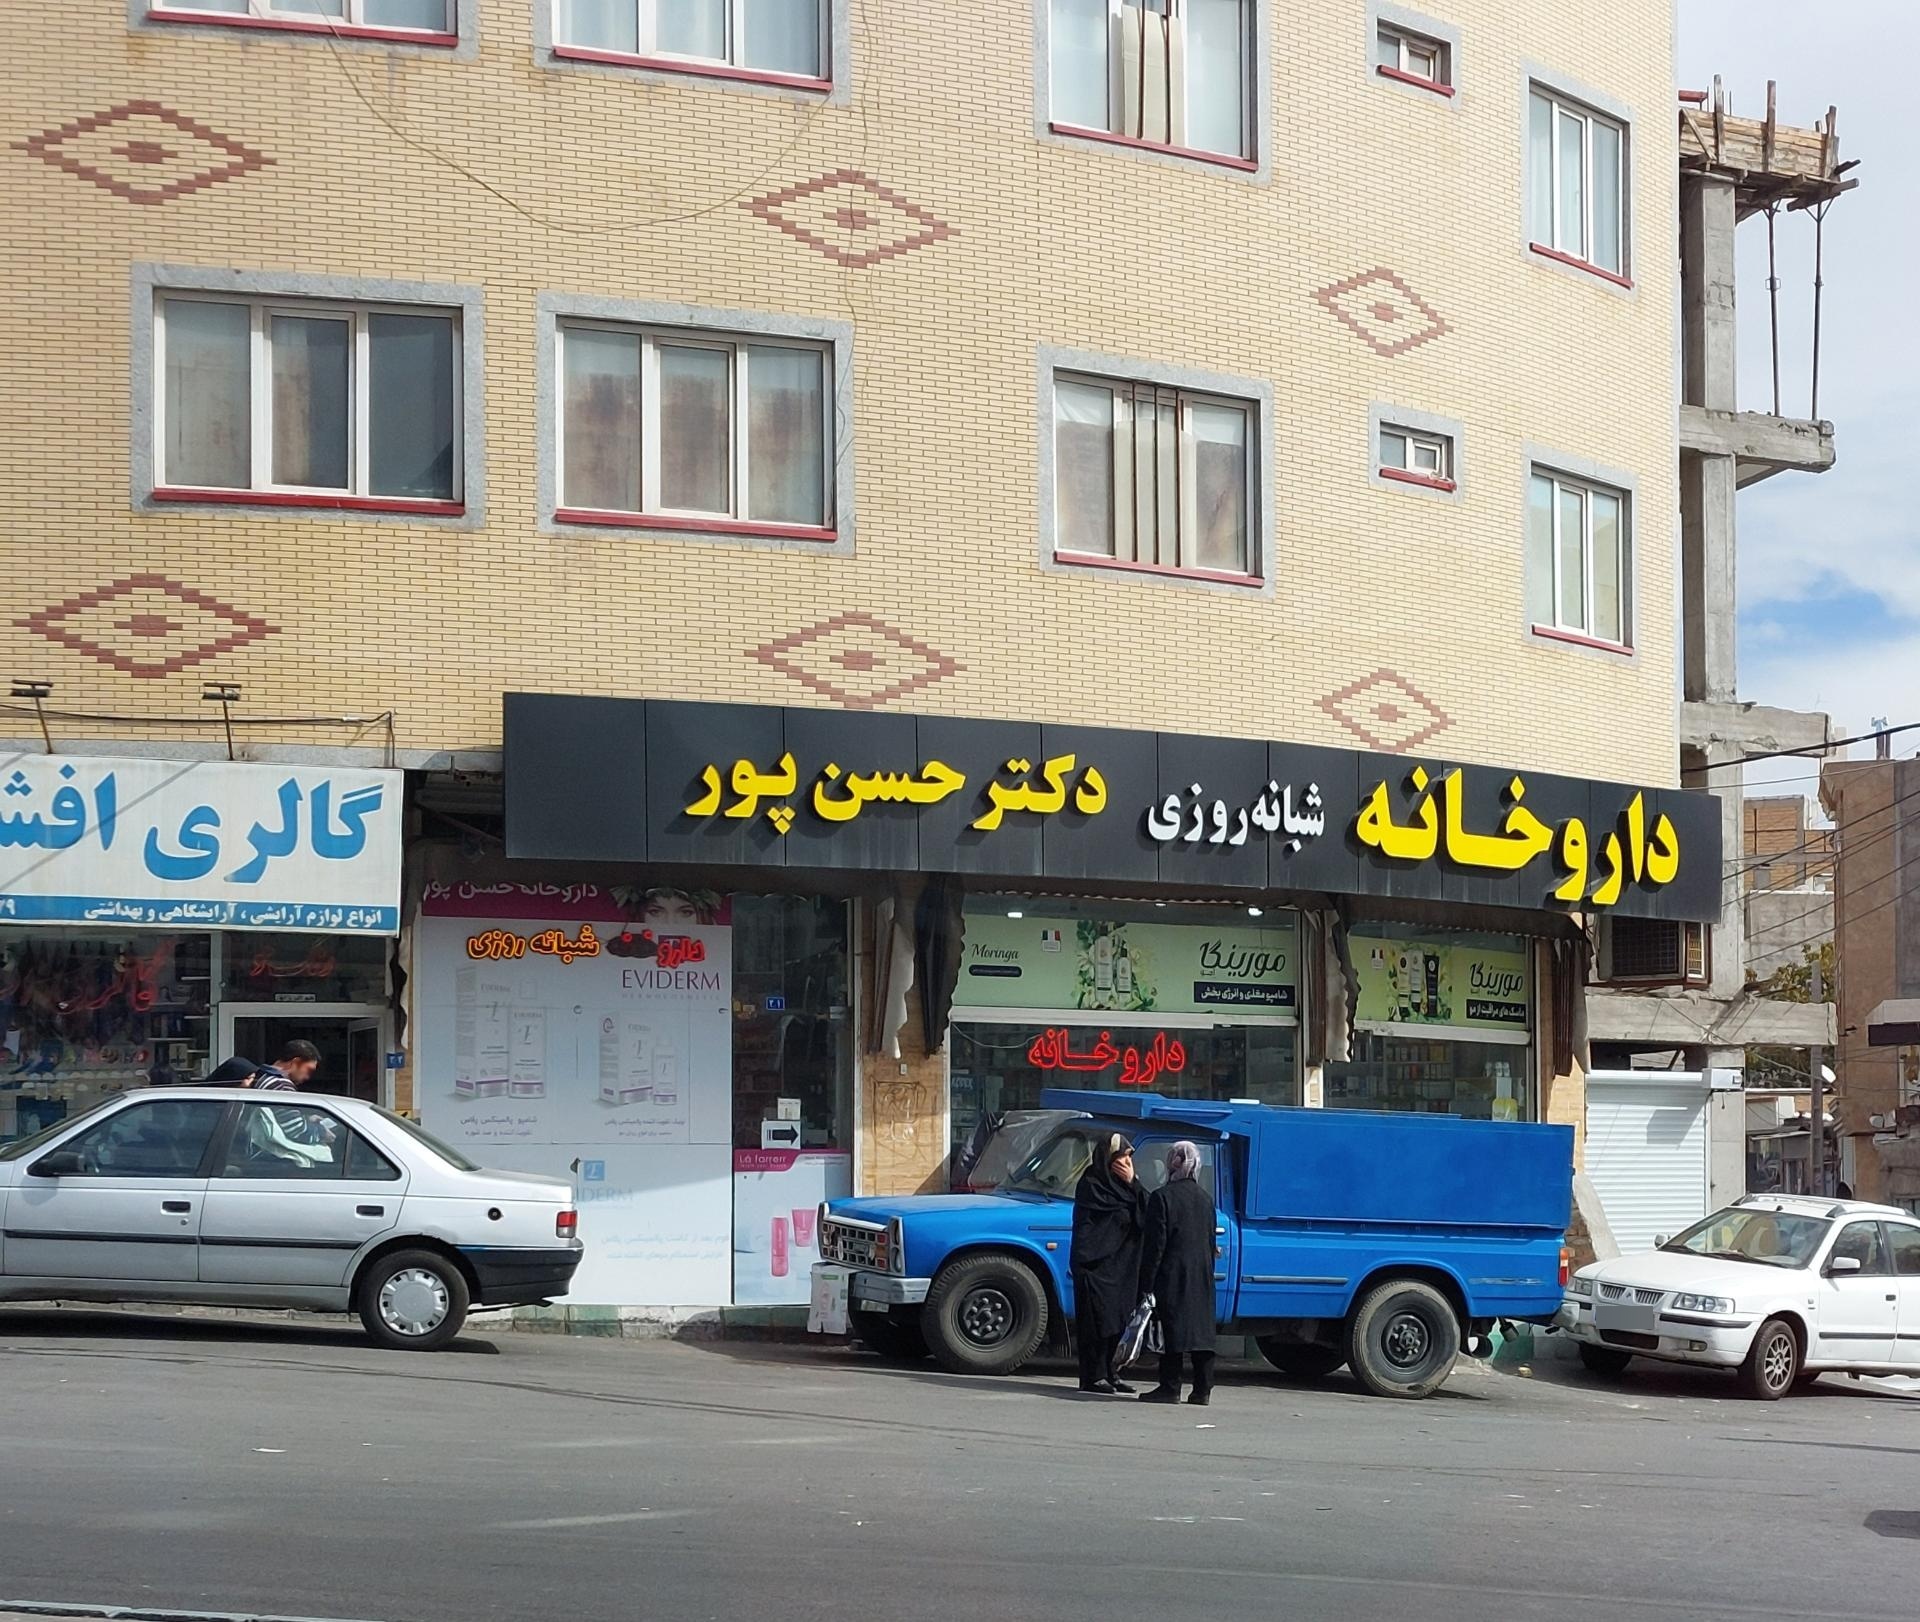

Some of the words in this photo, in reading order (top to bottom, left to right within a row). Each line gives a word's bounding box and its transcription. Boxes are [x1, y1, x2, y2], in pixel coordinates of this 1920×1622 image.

[685, 751, 799, 835] پور
[812, 760, 967, 822] حسن
[969, 753, 1108, 830] دکتر
[143, 776, 385, 884] گالری
[1147, 782, 1249, 846] روزی
[1250, 779, 1326, 853] شبانه
[1357, 765, 1679, 906] داروخانه
[84, 900, 144, 920] بهداشتی
[146, 906, 156, 922] و
[158, 902, 238, 924] آرایشگاهی
[306, 905, 344, 928] لوازم
[347, 907, 383, 929] انواع
[467, 929, 527, 961] روزی
[529, 924, 601, 964] شبانه
[971, 942, 1020, 962] Moringa
[1199, 938, 1287, 979] مورینگا
[621, 968, 721, 991] EVIDERM
[1469, 960, 1525, 998] مورینگا
[1028, 1027, 1186, 1086] داروخانه
